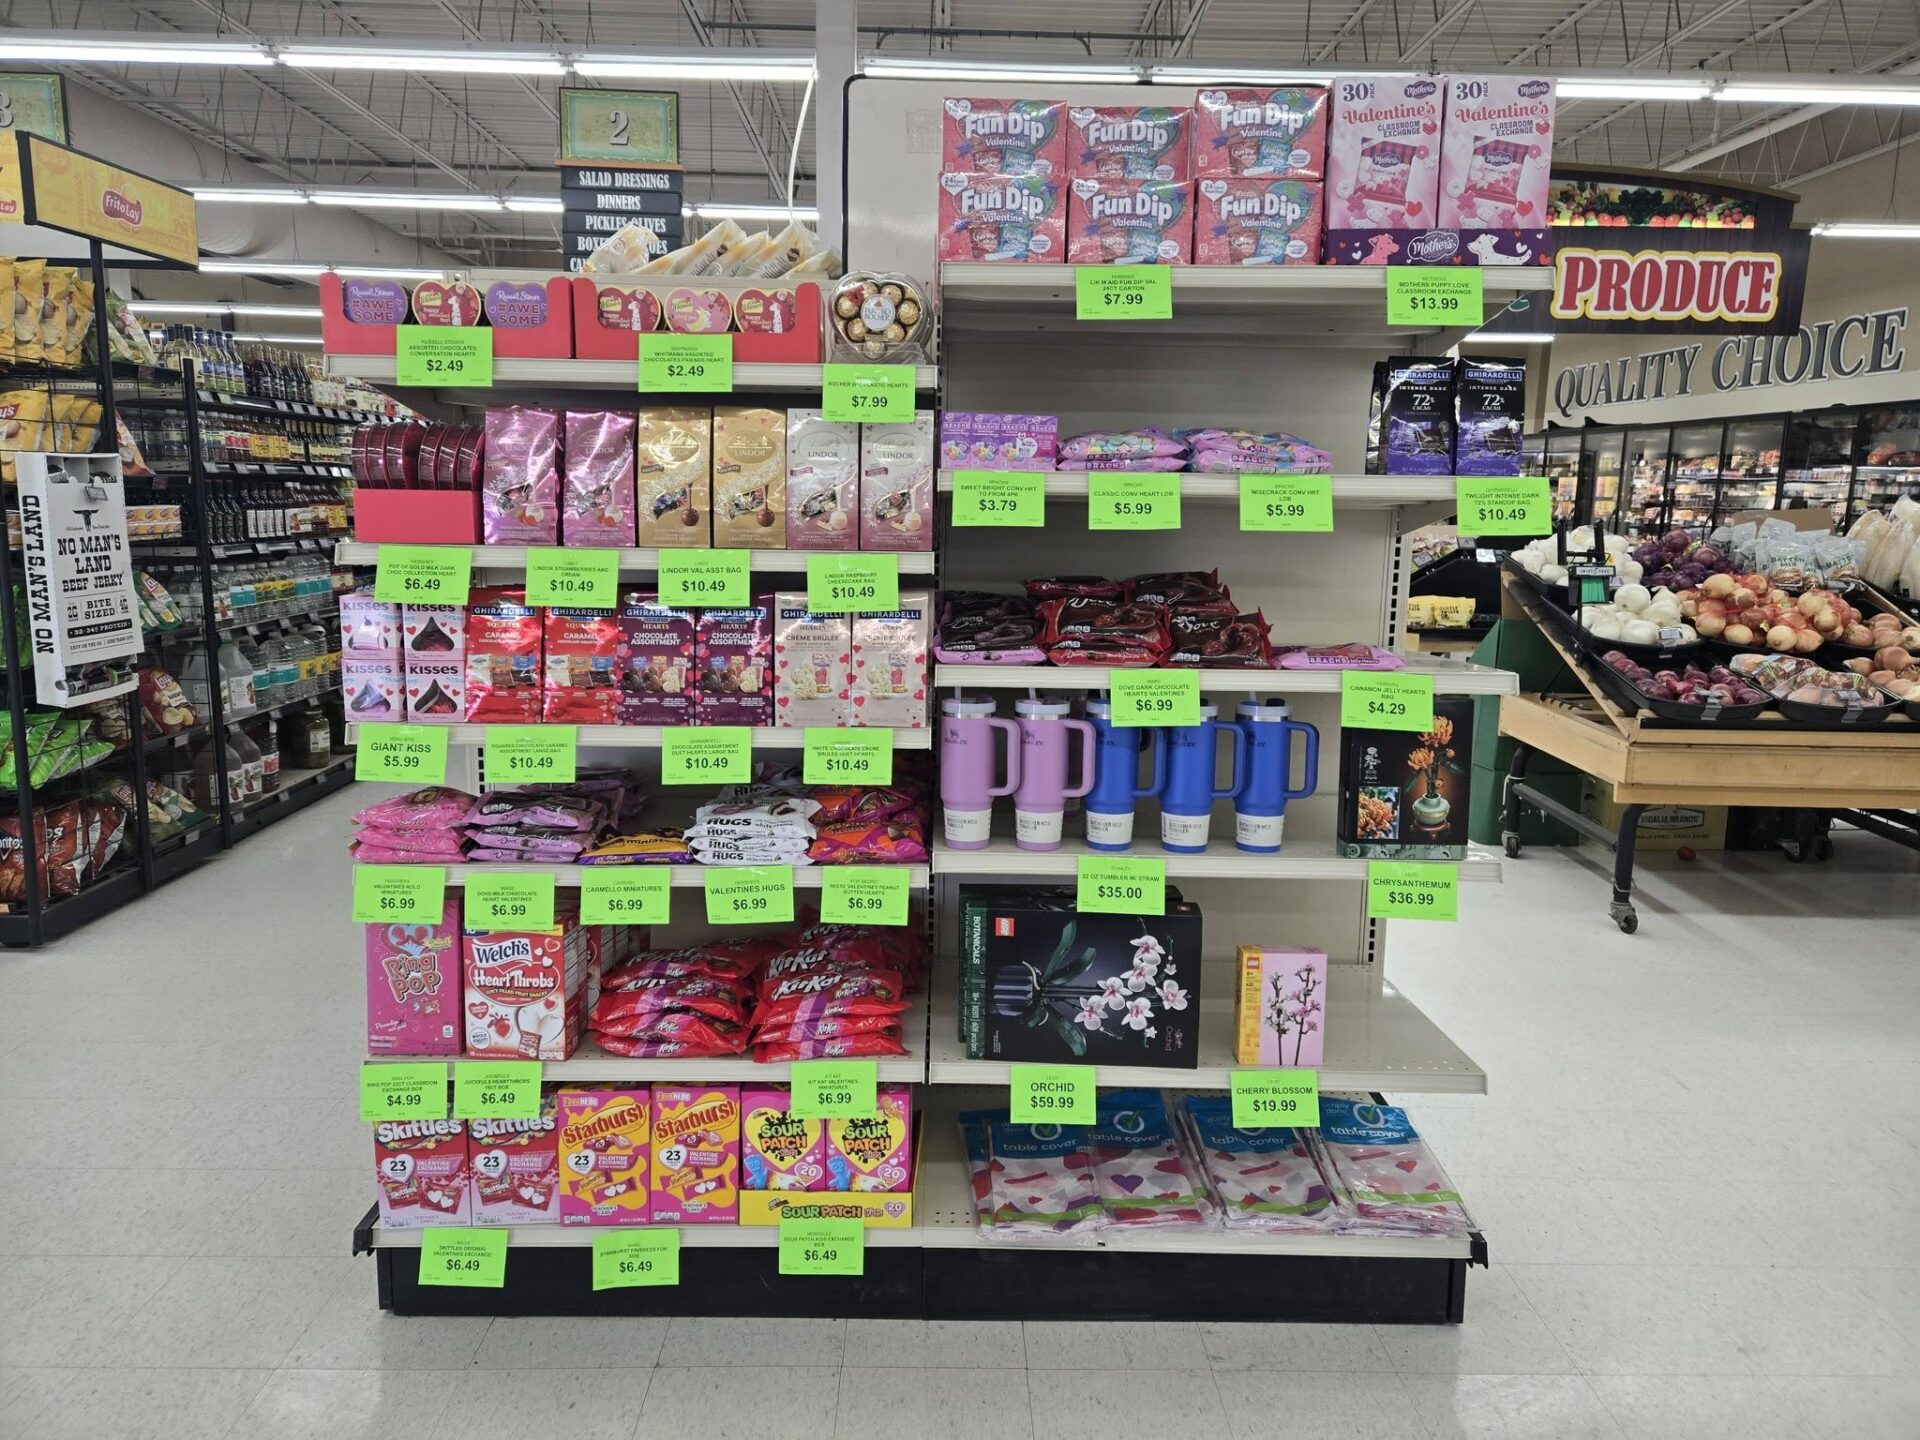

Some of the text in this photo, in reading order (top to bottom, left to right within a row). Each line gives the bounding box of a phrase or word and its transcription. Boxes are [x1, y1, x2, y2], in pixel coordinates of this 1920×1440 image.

[1342, 83, 1369, 102] 30
[1456, 81, 1483, 100] 30
[1220, 103, 1304, 134] Fun Dip
[1342, 103, 1436, 125] Valentine's
[1455, 102, 1549, 123] Valentine's
[610, 111, 629, 145] 2
[964, 112, 1046, 144] Fun Dip
[1377, 121, 1420, 132] CLASSROOM
[1490, 120, 1534, 130] CLASSROOM
[1088, 119, 1168, 150] Fun Dip
[1383, 127, 1421, 138] EXCHANGE
[1496, 127, 1534, 137] EXCHANGE
[579, 171, 669, 188] SALAD DRESSINGS
[597, 194, 640, 209] DINNERS
[961, 188, 1043, 218] Fun Dip
[1220, 193, 1301, 223] Fun Dip
[1092, 193, 1172, 226] Fun Dip
[1412, 235, 1459, 256] Mother's
[1559, 256, 1775, 314] PRODUCE
[1104, 293, 1143, 306] $7.99
[1411, 297, 1458, 310] $13.99
[427, 359, 463, 372] $2.49
[1554, 308, 1908, 417] QUALITY CHOICE
[668, 365, 704, 377] $2.49
[1468, 371, 1520, 379] GHIRARDELLI
[852, 395, 888, 408] $7.99
[979, 499, 1017, 512] $3.79
[1114, 502, 1152, 515] $5.99
[1266, 504, 1304, 517] $5.99
[1479, 508, 1526, 521] $10.49
[57, 534, 121, 555] NO MAN'S
[75, 555, 111, 574] LAND
[23, 495, 54, 654] NO MAN'S LAND
[62, 574, 122, 592] BEEF JERKY
[405, 578, 440, 591] $6.49
[550, 579, 594, 592] $10.49
[682, 580, 725, 592] $10.49
[832, 586, 875, 599] $10.49
[87, 598, 111, 609] BITE
[85, 608, 115, 620] SIZED
[474, 607, 534, 616] GHIRARDELLI
[553, 608, 612, 616] GHIRARDELLI
[626, 608, 687, 617] GHIRARDELLI
[783, 610, 843, 618] GHIRARDELLI
[346, 665, 391, 674] KISSES
[410, 665, 458, 675] KISSES
[1136, 699, 1173, 712] $6.99
[1368, 701, 1406, 715] $4.29
[371, 742, 431, 753] GIANT KISS
[384, 755, 419, 768] $5.99
[510, 757, 553, 769] $10.49
[686, 757, 728, 770] $10.49
[826, 759, 869, 771] $10.49
[707, 818, 752, 826] HUGS
[1641, 815, 1698, 824] VIDALIA BRANDS
[712, 851, 744, 861] HUGS
[710, 884, 785, 895] VALENTINES HUGS
[1373, 878, 1451, 889] CHRYSANTHEMUM
[1098, 885, 1142, 899] $35.00
[1389, 891, 1434, 905] $36.99
[380, 897, 415, 909] $6.99
[608, 899, 643, 911] $6.99
[733, 898, 767, 911] $6.99
[848, 897, 882, 909] $6.99
[492, 904, 526, 916] $6.99
[973, 916, 981, 964] BOTANICALS
[475, 940, 531, 963] Welch's
[384, 954, 437, 979] Ring
[473, 970, 554, 988] Heart Throbs
[1031, 1082, 1075, 1092] ORCHID
[1236, 1087, 1313, 1095] CHERRY BLOSSOM
[387, 1094, 421, 1107] $4.99
[481, 1092, 515, 1105] $6.49
[818, 1092, 851, 1105] $6.99
[1031, 1096, 1074, 1109] $59.99
[1253, 1099, 1296, 1112] $19.99
[563, 1103, 646, 1145] Starburst
[655, 1100, 736, 1140] Starburst
[378, 1119, 462, 1142] Skittles
[472, 1116, 555, 1139] Skittles
[761, 1123, 803, 1137] SOUR
[844, 1126, 888, 1138] SOUR
[1330, 1127, 1406, 1138] table cover
[761, 1135, 807, 1150] PATCH
[843, 1138, 891, 1151] PATCH
[390, 1161, 406, 1171] 23
[483, 1157, 500, 1167] 23
[574, 1155, 590, 1166] 23
[801, 1167, 817, 1177] 20
[782, 1206, 863, 1218] SOUR PATCH
[804, 1249, 837, 1261] $6.49
[446, 1259, 480, 1271] $6.49
[619, 1261, 652, 1274] $6.49
